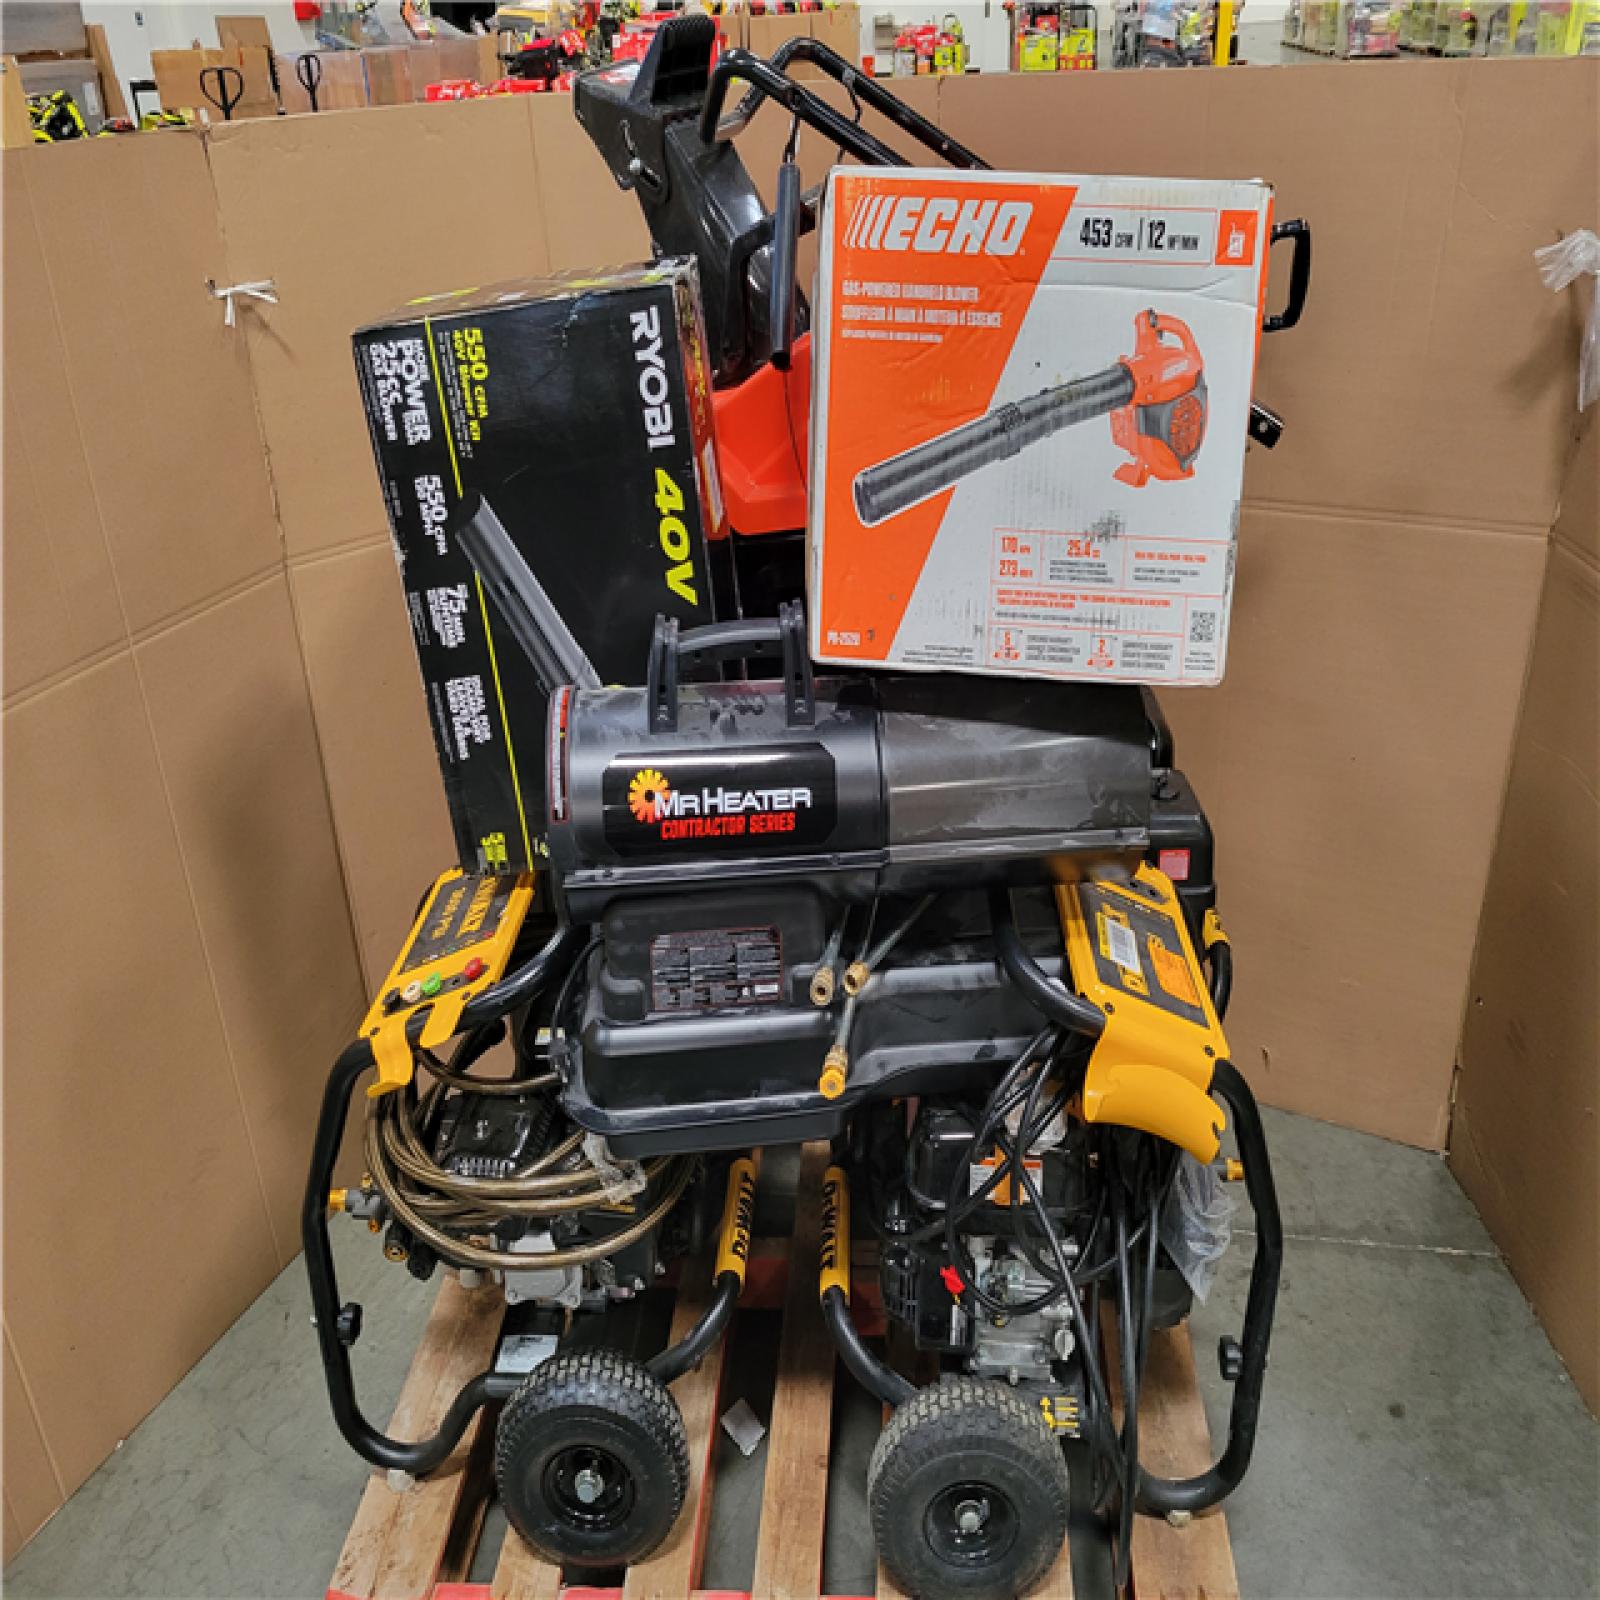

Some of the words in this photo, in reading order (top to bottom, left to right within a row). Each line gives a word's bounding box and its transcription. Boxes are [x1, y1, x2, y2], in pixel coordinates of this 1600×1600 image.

[884, 197, 1034, 256] ECHO
[1079, 217, 1113, 249] 453
[1147, 219, 1166, 249] 12
[464, 327, 489, 381] 550
[376, 379, 398, 441] BLOWER
[397, 339, 431, 441] POWER
[629, 305, 676, 452] RYOBI
[654, 467, 698, 606] 40V
[425, 475, 449, 522] 550
[446, 582, 468, 614] 75
[661, 815, 746, 840] CONTRACTOR
[749, 811, 796, 834] SERIES
[702, 786, 812, 816] HEATER
